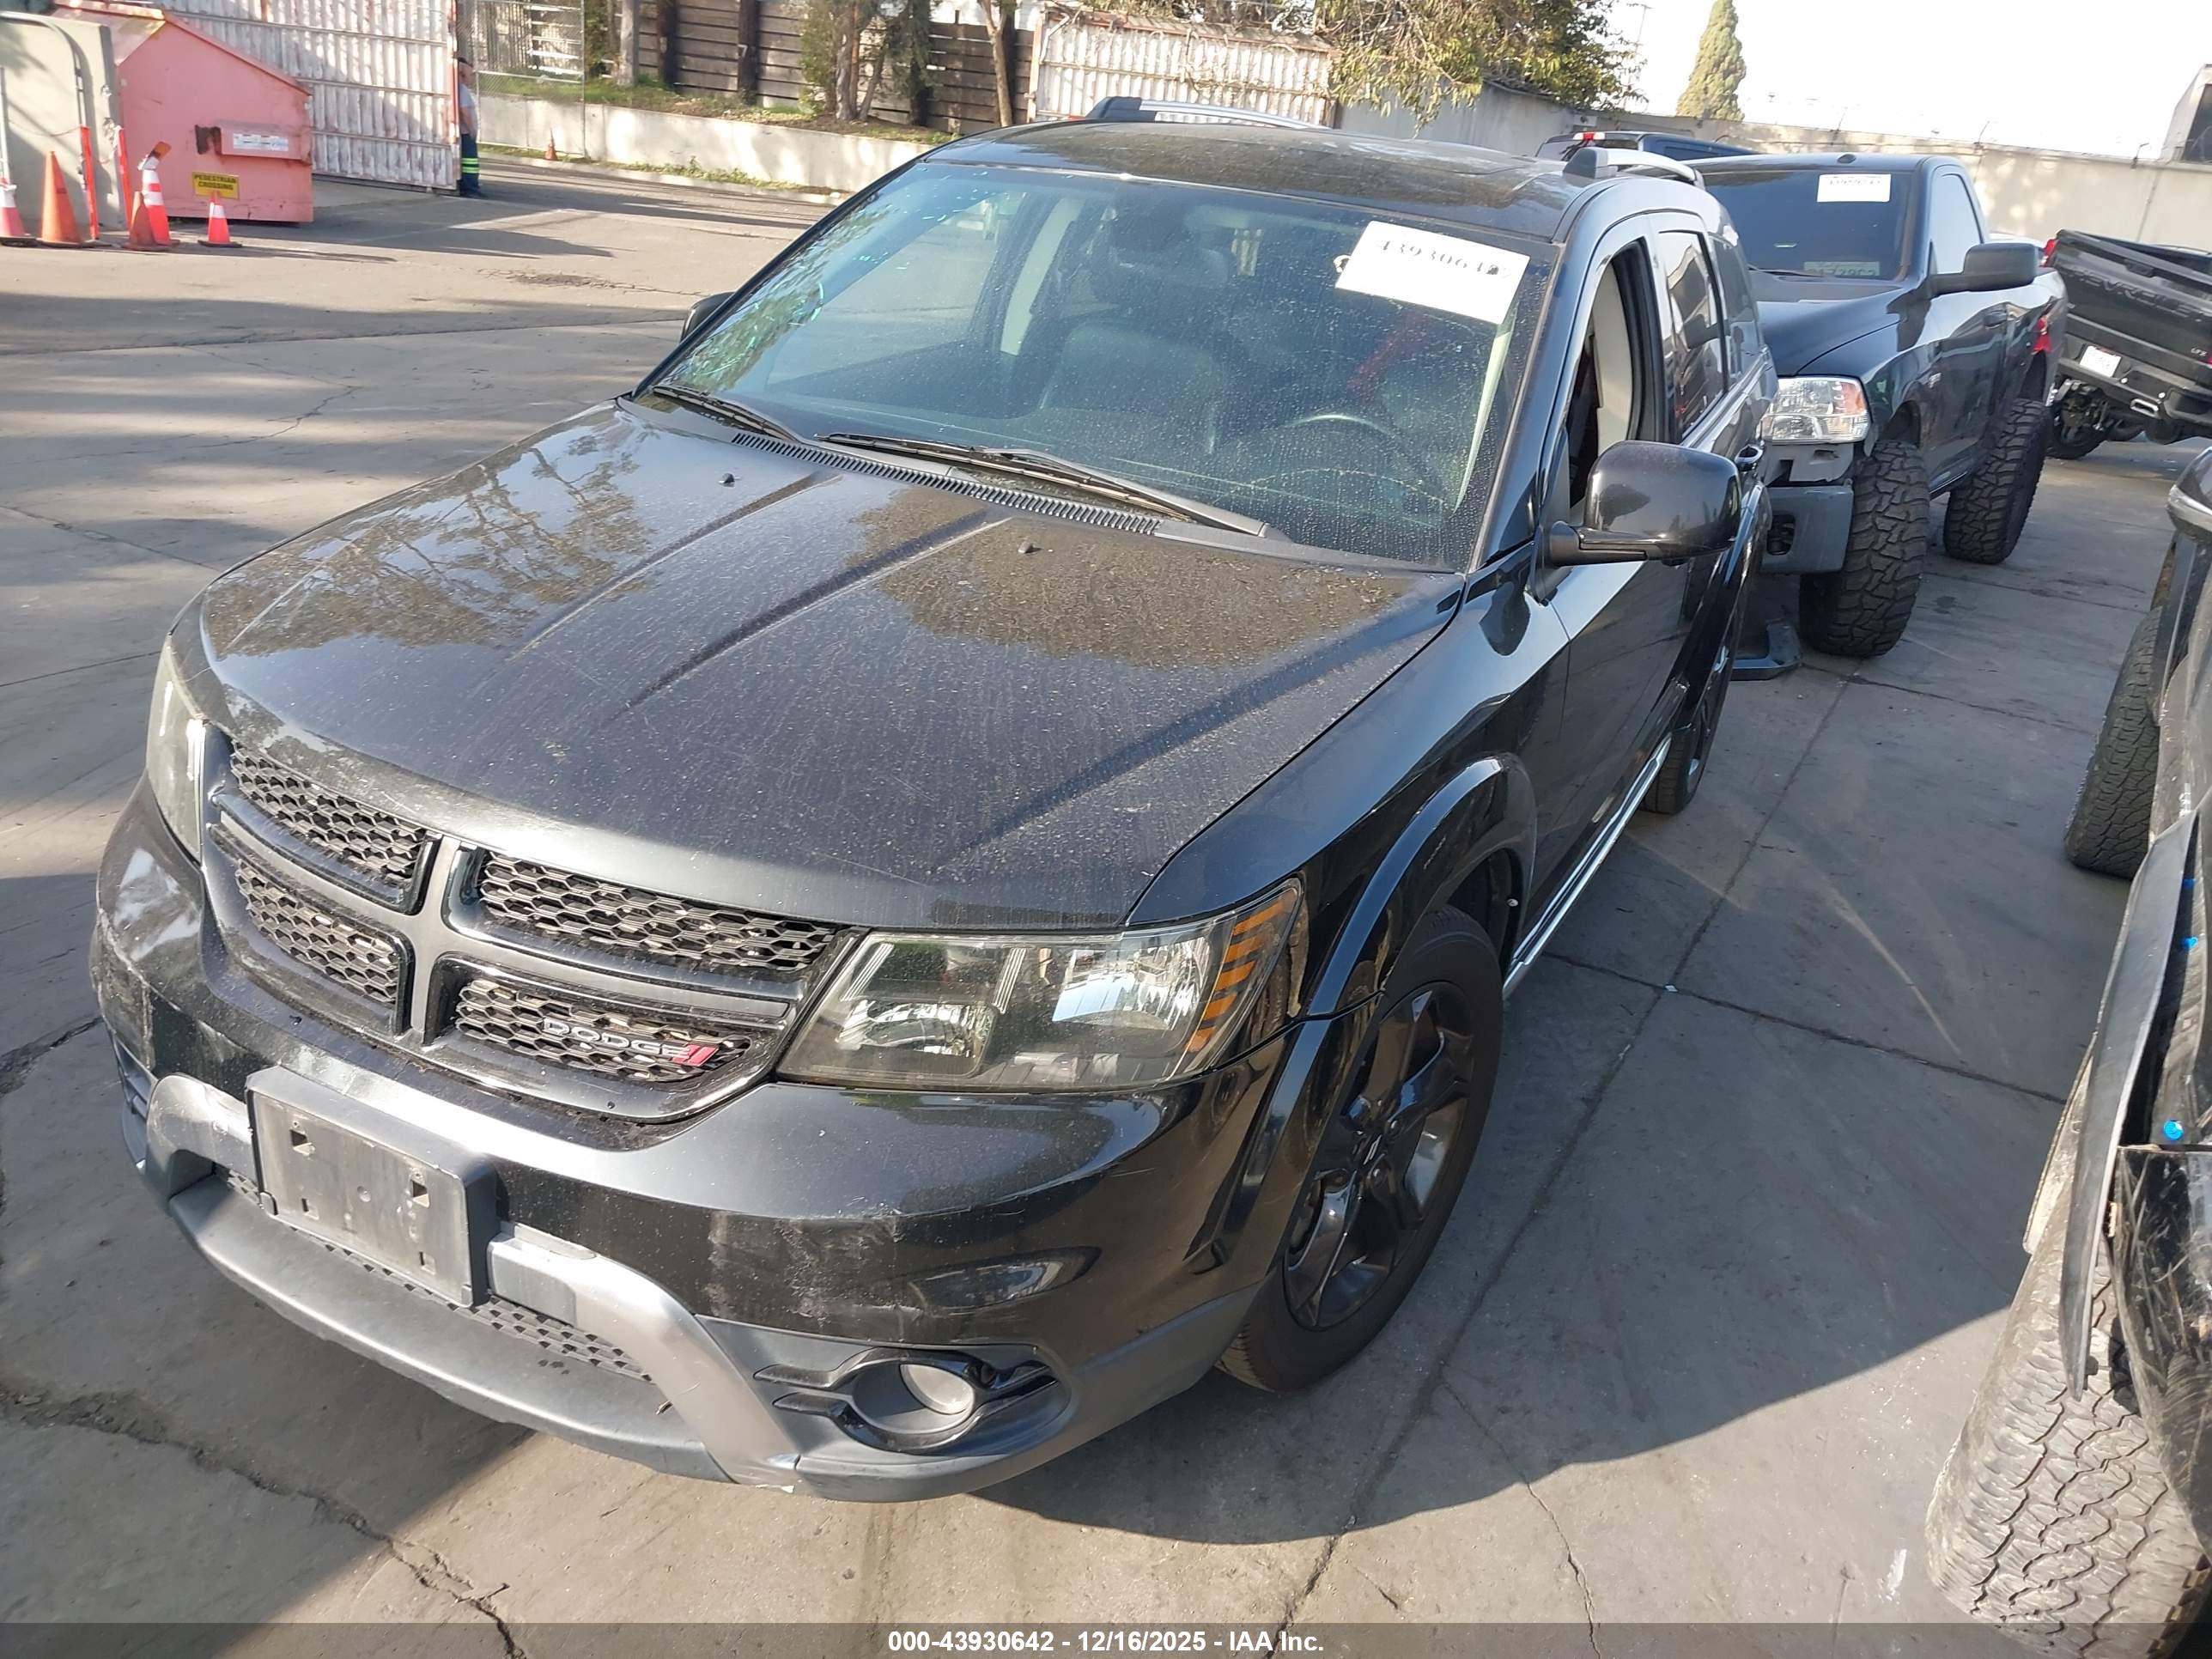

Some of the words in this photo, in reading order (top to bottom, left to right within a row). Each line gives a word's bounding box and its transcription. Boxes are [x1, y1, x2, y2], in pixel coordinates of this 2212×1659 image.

[194, 174, 236, 183] PEDESTRIAN
[198, 181, 234, 190] CROSSING
[543, 1018, 691, 1060] DODGE
